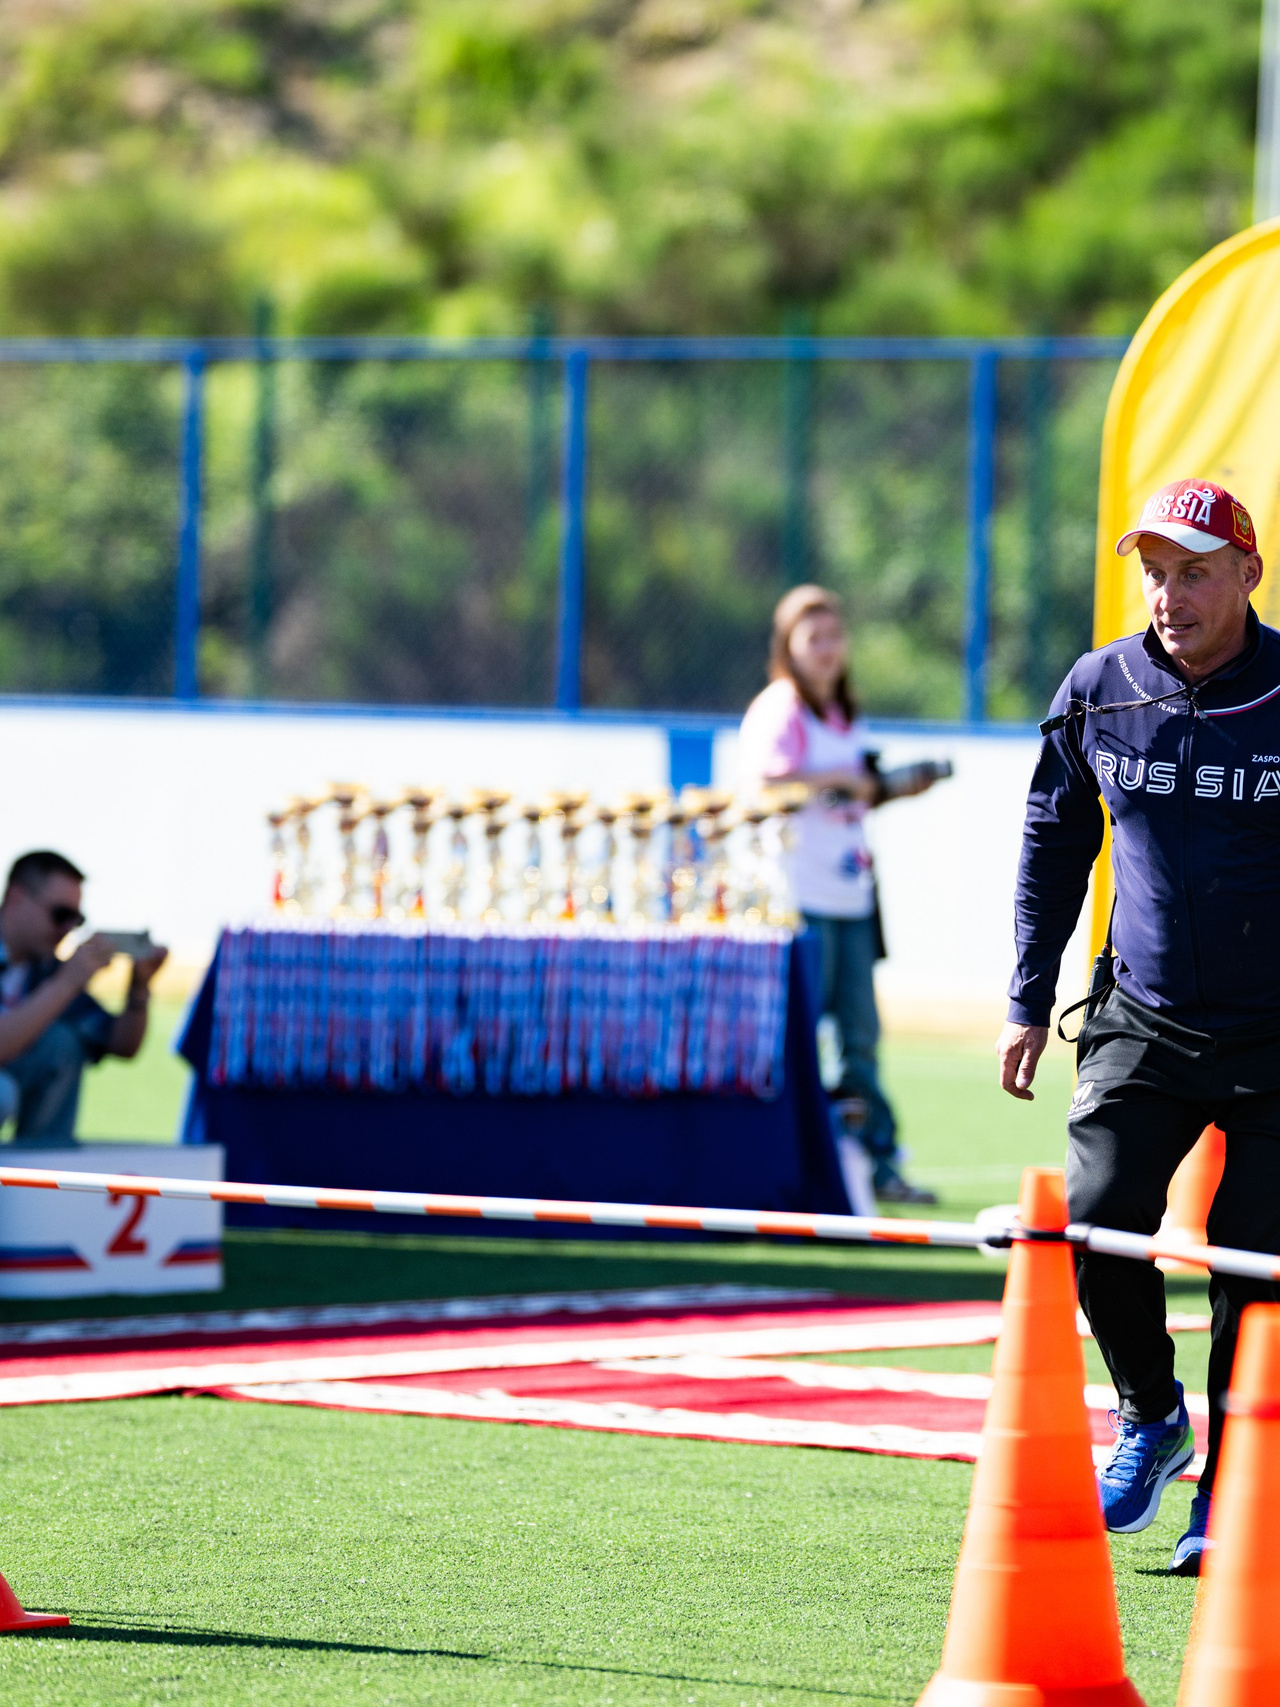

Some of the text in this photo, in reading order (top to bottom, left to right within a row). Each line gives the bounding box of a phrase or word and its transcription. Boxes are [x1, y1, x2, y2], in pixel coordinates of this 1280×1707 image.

[1117, 653, 1178, 714] RUSSIAN OLYMPI TEAM
[106, 1173, 148, 1257] 2
